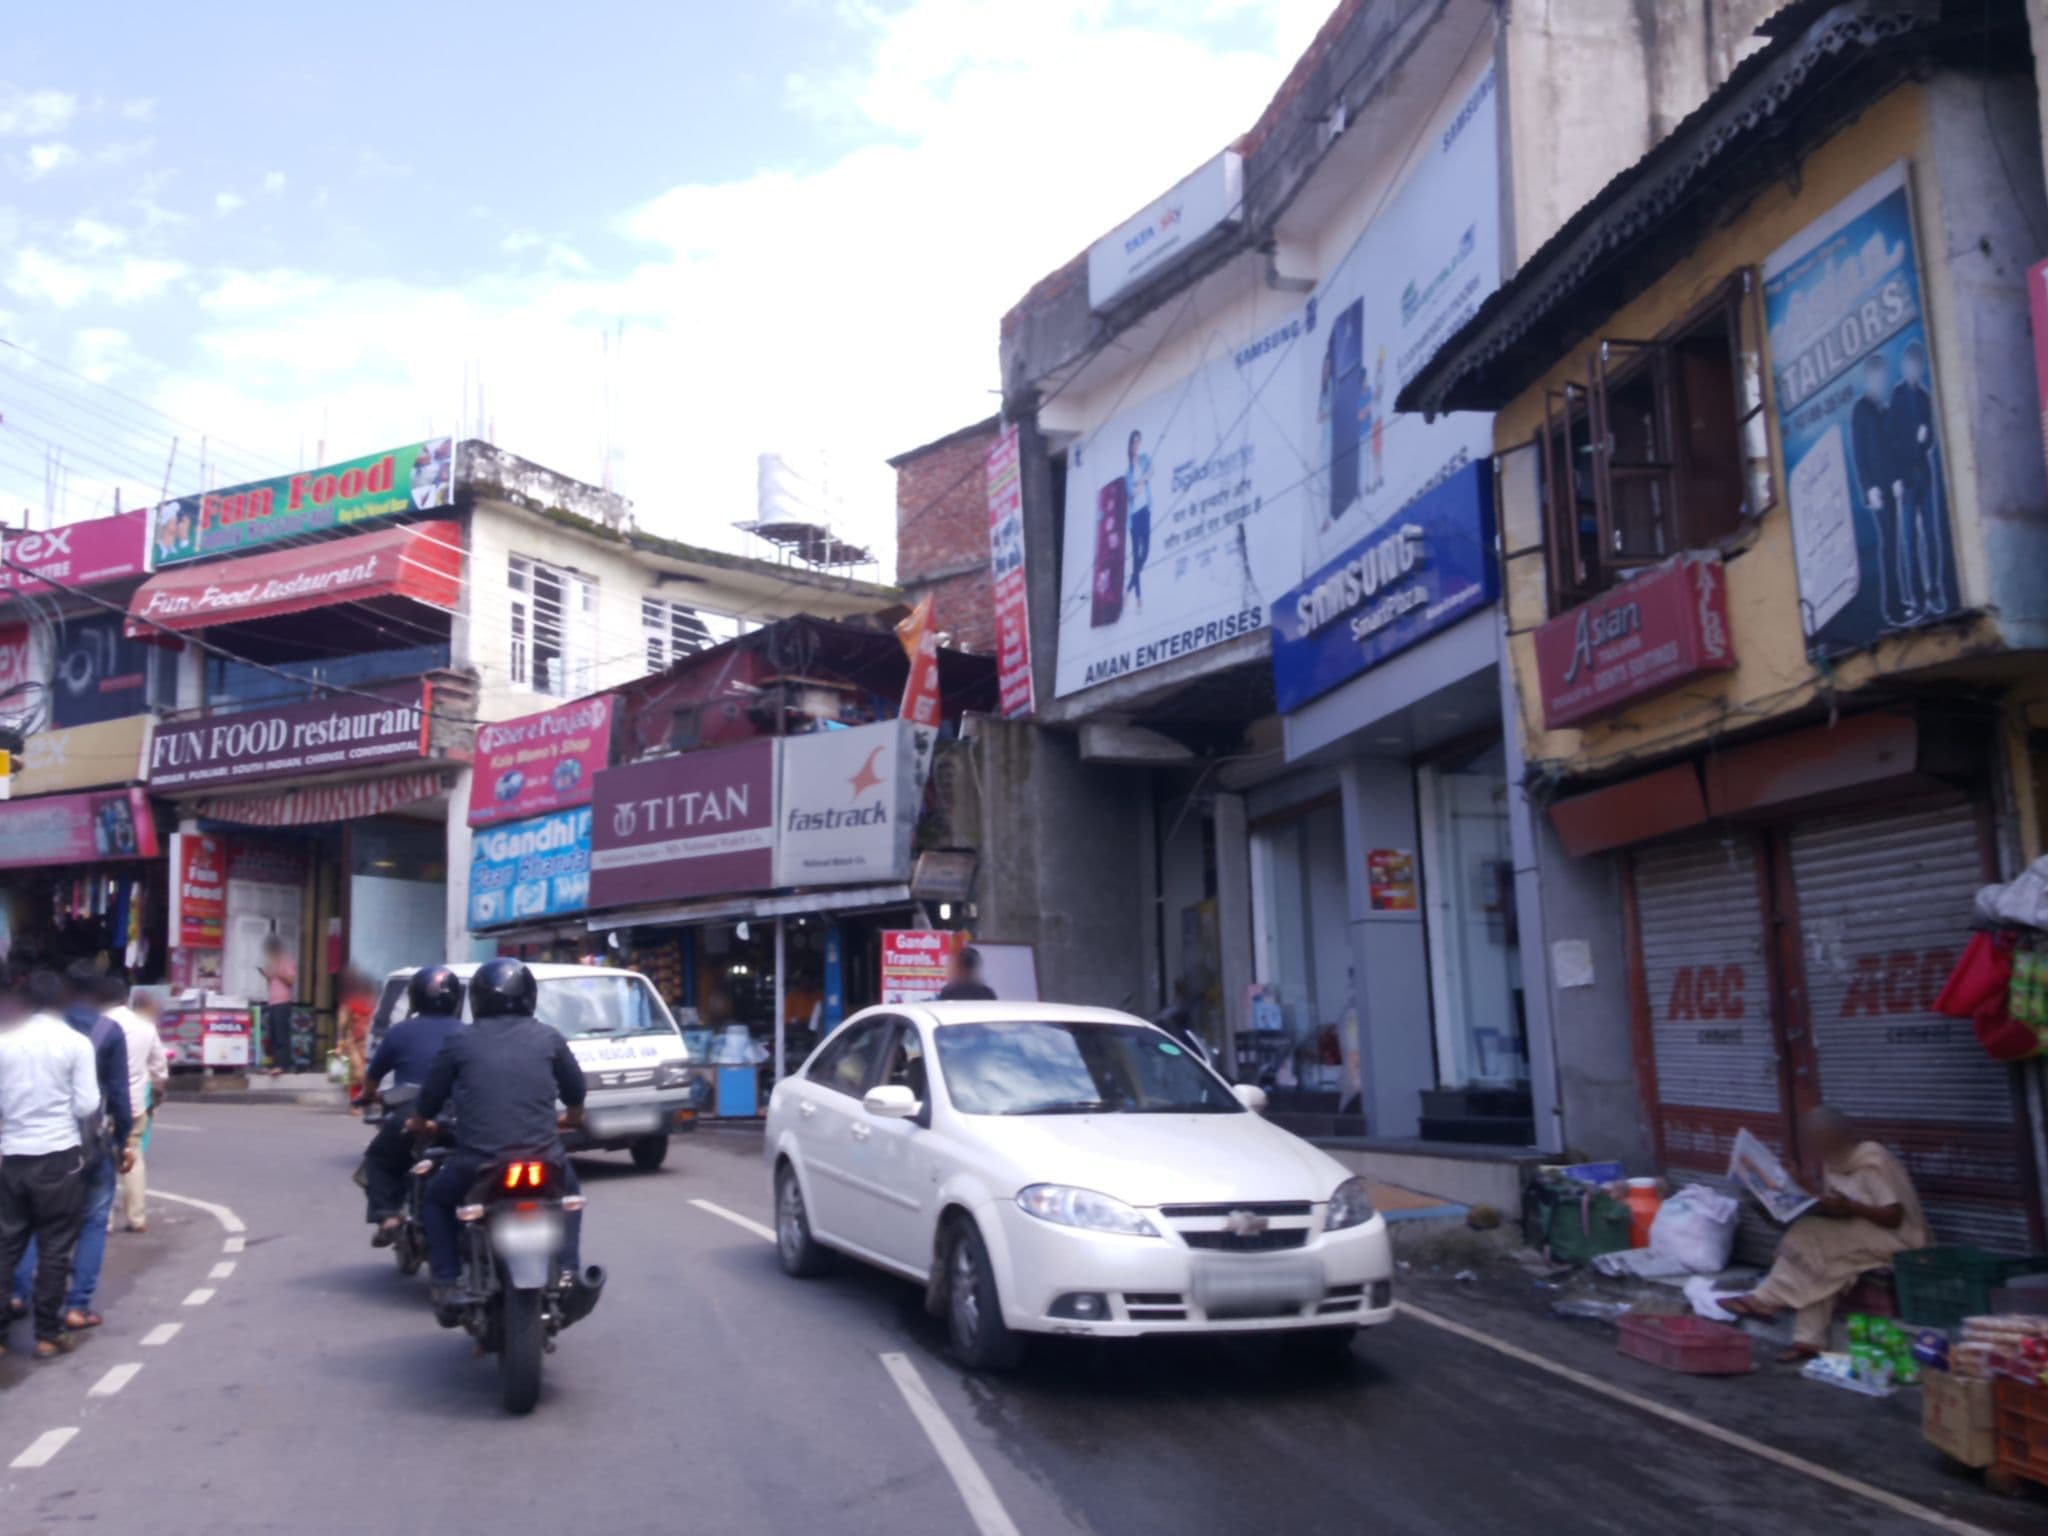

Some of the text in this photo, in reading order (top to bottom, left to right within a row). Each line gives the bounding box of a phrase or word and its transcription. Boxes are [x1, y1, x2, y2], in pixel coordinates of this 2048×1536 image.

[1235, 319, 1300, 369] SAMSUNG
[1782, 280, 1905, 411] TAILORS
[202, 489, 274, 531] Fun
[286, 456, 395, 512] Food
[140, 554, 379, 617] Fun Food Restaurant
[1296, 522, 1424, 638] SAMSUNG
[1084, 606, 1263, 685] AMAN ENTERPRISES
[1563, 602, 1641, 685] Asian
[152, 699, 422, 769] FUN FOOD restaurant
[489, 815, 576, 862] Gandhi
[640, 784, 749, 832] TITAN
[787, 800, 888, 833] fastrack
[895, 934, 941, 950] Gandhi
[1665, 964, 1745, 1022] ACC
